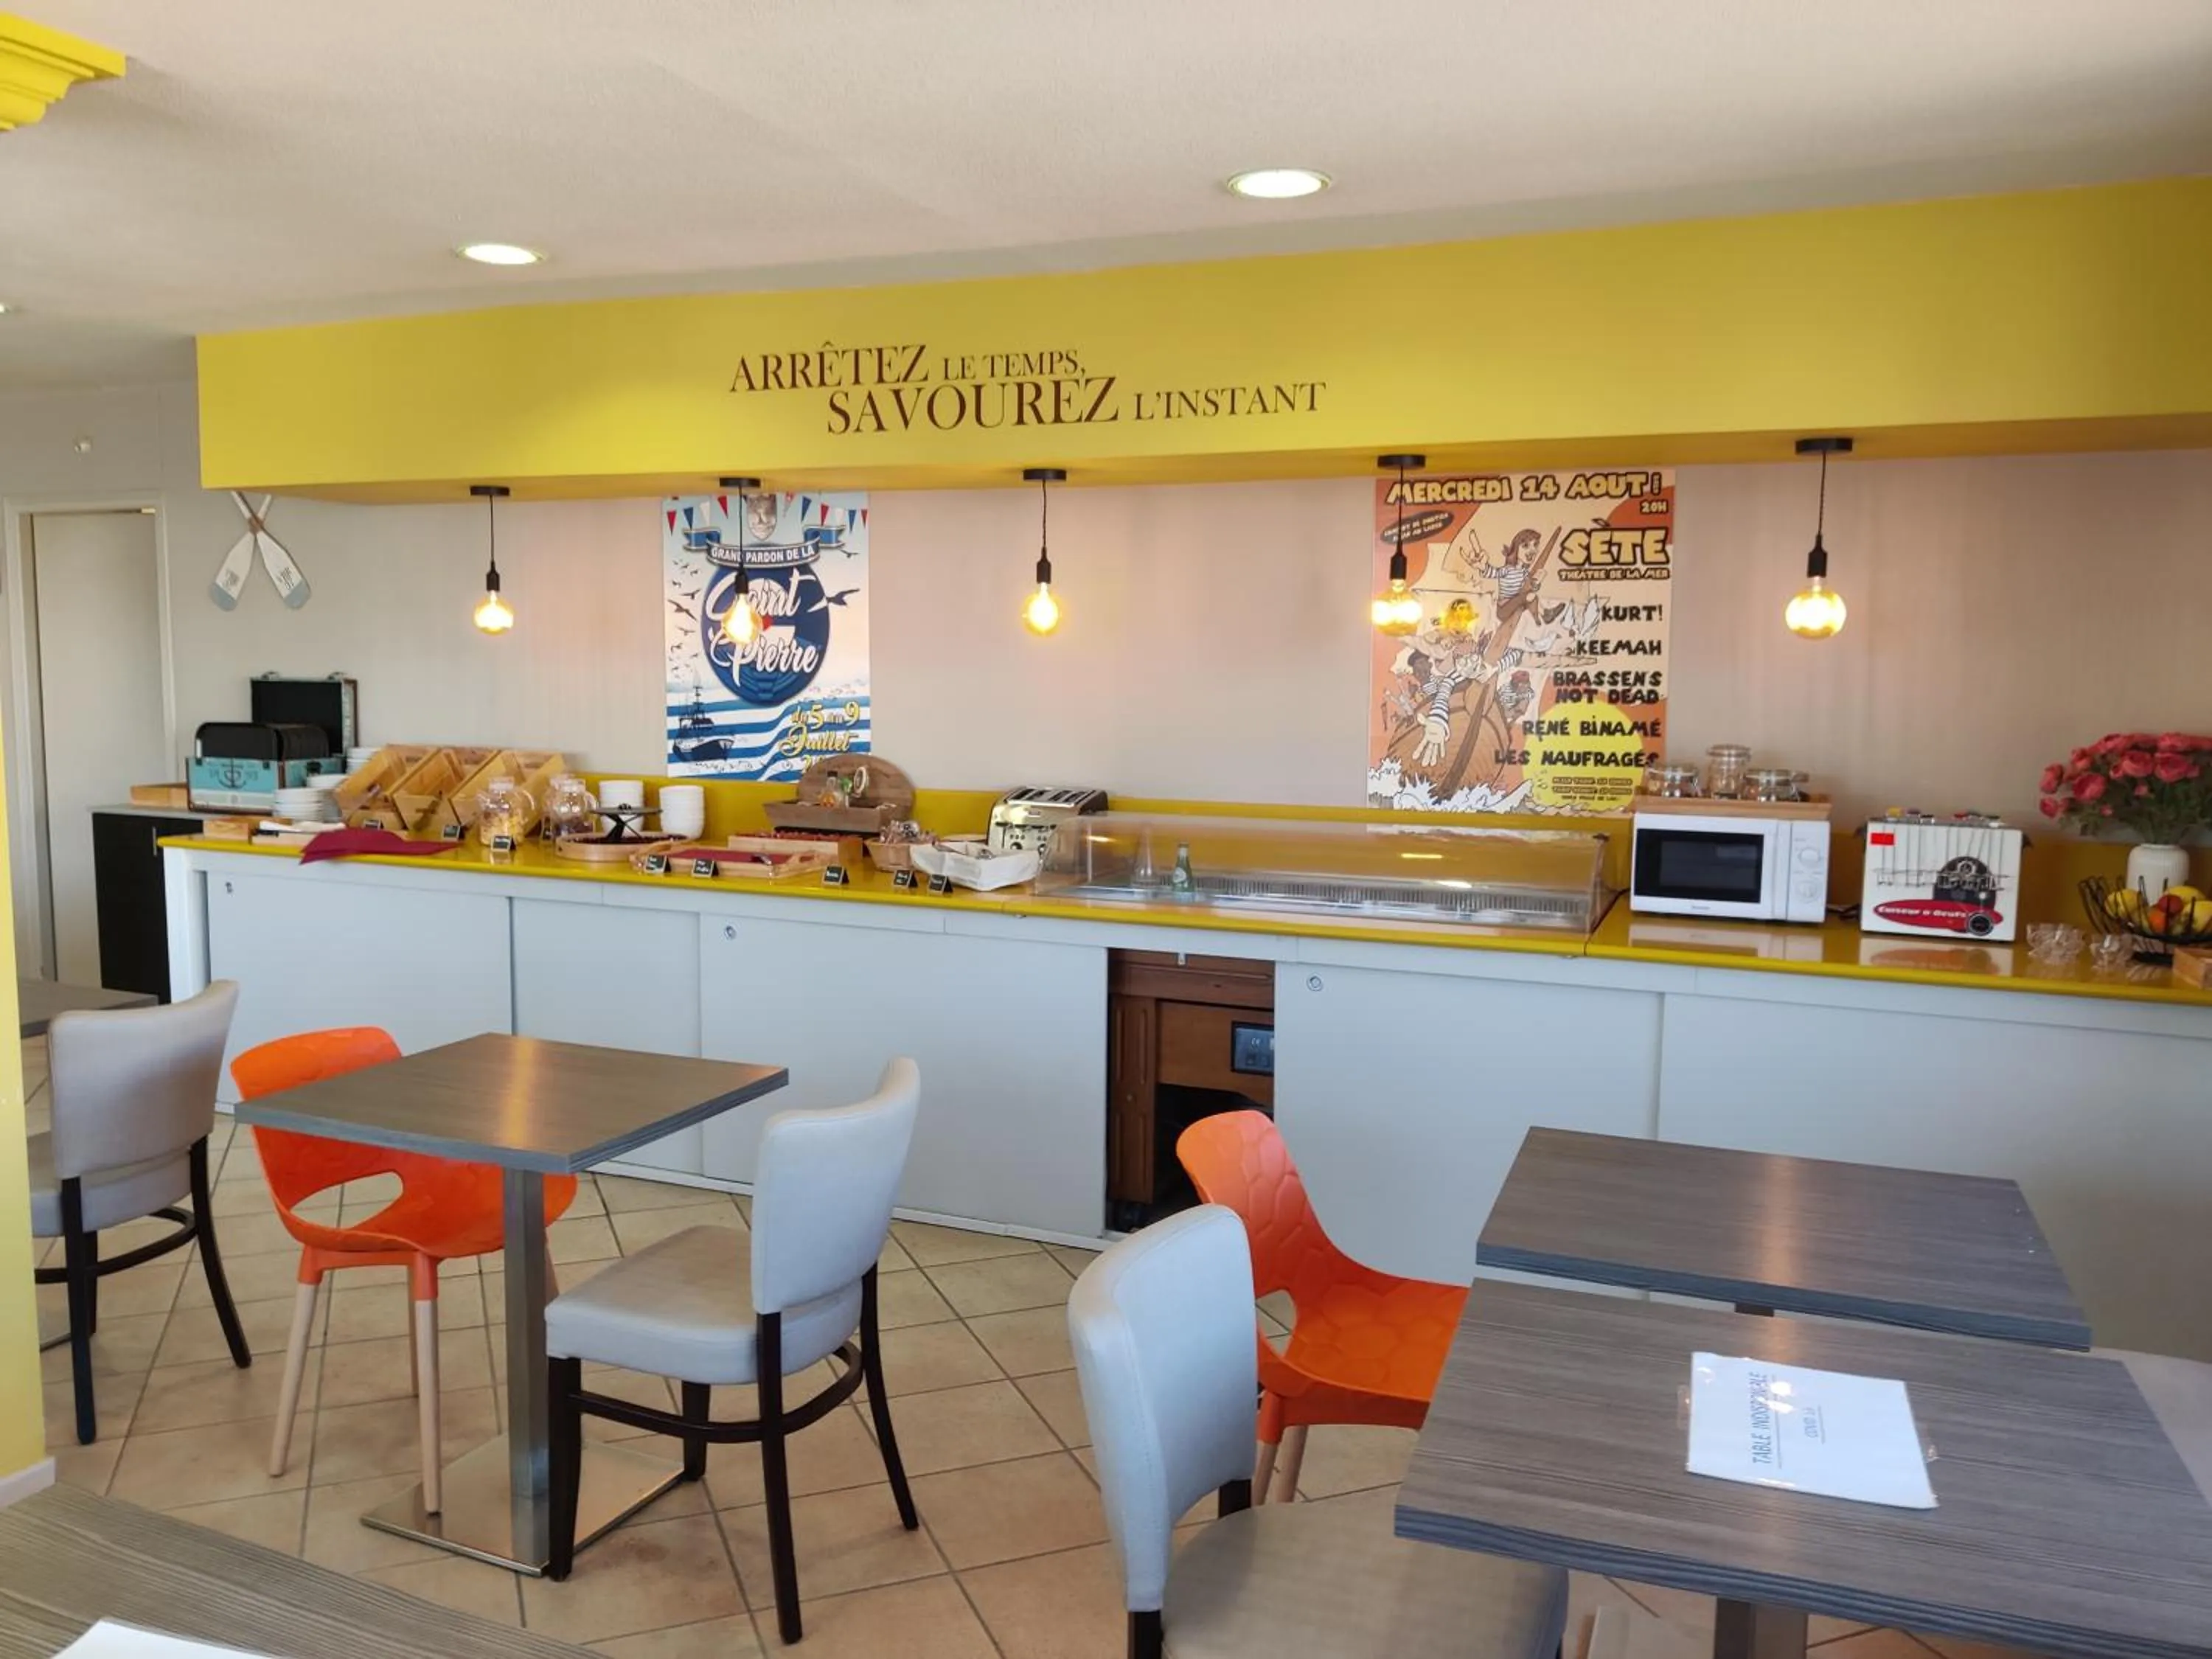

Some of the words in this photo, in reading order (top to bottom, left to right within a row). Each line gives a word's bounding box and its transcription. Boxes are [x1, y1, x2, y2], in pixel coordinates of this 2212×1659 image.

[731, 342, 929, 392] ARRÊTEZ
[943, 356, 975, 380] LE
[982, 349, 1088, 380] TEMPS,
[827, 376, 1119, 434] SAVOUREZ
[1134, 381, 1327, 421] L'INSTANT
[1385, 476, 1512, 504] MERCREDI
[1520, 475, 1560, 501] 14
[1565, 472, 1649, 498] AOUT
[1640, 499, 1669, 514] 20H
[745, 552, 784, 563] PARDON
[787, 548, 799, 560] DE
[801, 545, 815, 557] LA
[1601, 605, 1663, 622] KURT!
[1576, 639, 1662, 655] KEEMAH
[1553, 671, 1663, 686] BRASSENS
[1555, 688, 1599, 704] NOT
[1607, 688, 1660, 705] DEAD
[810, 703, 824, 730] 5
[844, 700, 860, 727] 9
[1521, 717, 1570, 737] RENÉ
[1494, 750, 1531, 765] LES
[1751, 1433, 1772, 1464] TABLE
